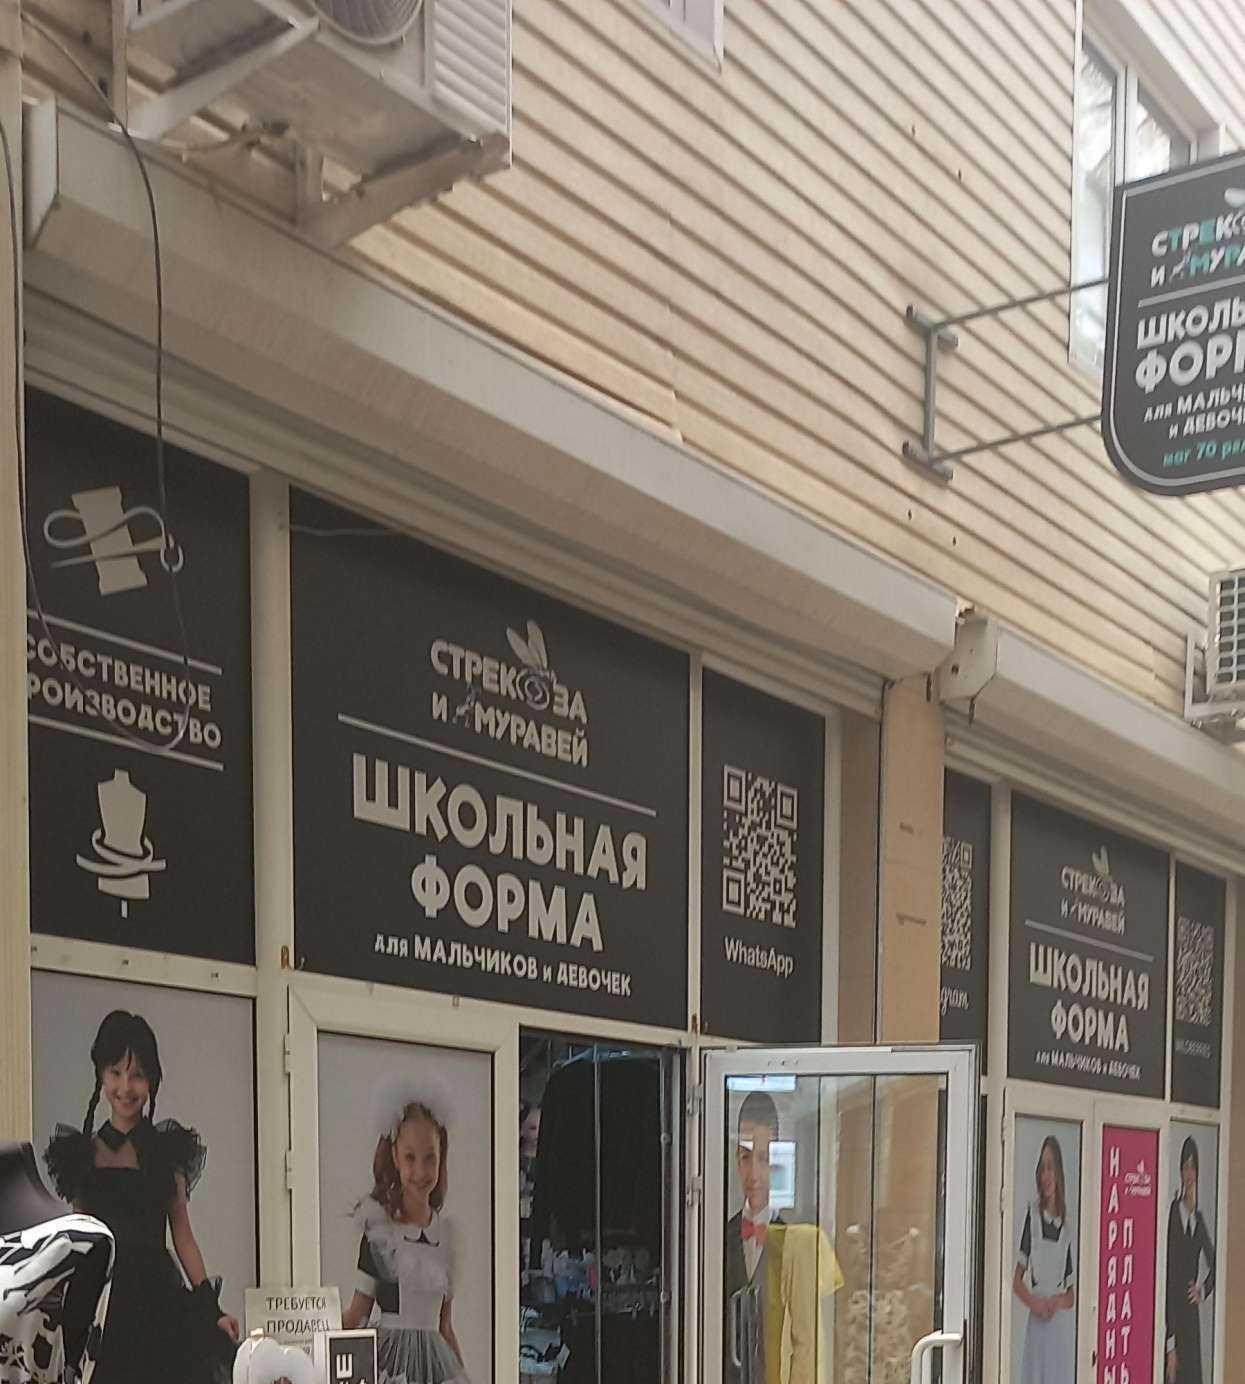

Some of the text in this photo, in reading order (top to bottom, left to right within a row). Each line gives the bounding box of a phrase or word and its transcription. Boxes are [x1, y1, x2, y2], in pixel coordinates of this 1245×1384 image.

[1151, 264, 1165, 289] И
[1177, 382, 1245, 416] МАЛЬЧ
[1183, 405, 1245, 437] ДЕВОЧ
[431, 637, 588, 725] СТРЕКОЗА
[432, 691, 588, 768] И МУРАВЕЙ
[353, 753, 647, 891] ШКОЛЬНАЯ
[411, 854, 604, 952] ФОРМА
[414, 934, 537, 980] МАЛЬЧИКОВ
[556, 961, 632, 997] ДЕВОЧЕК
[724, 936, 794, 979] WhatsApp
[1030, 942, 1149, 1011] ШКОЛЬНАЯ
[1051, 999, 1129, 1053] ФОРМА
